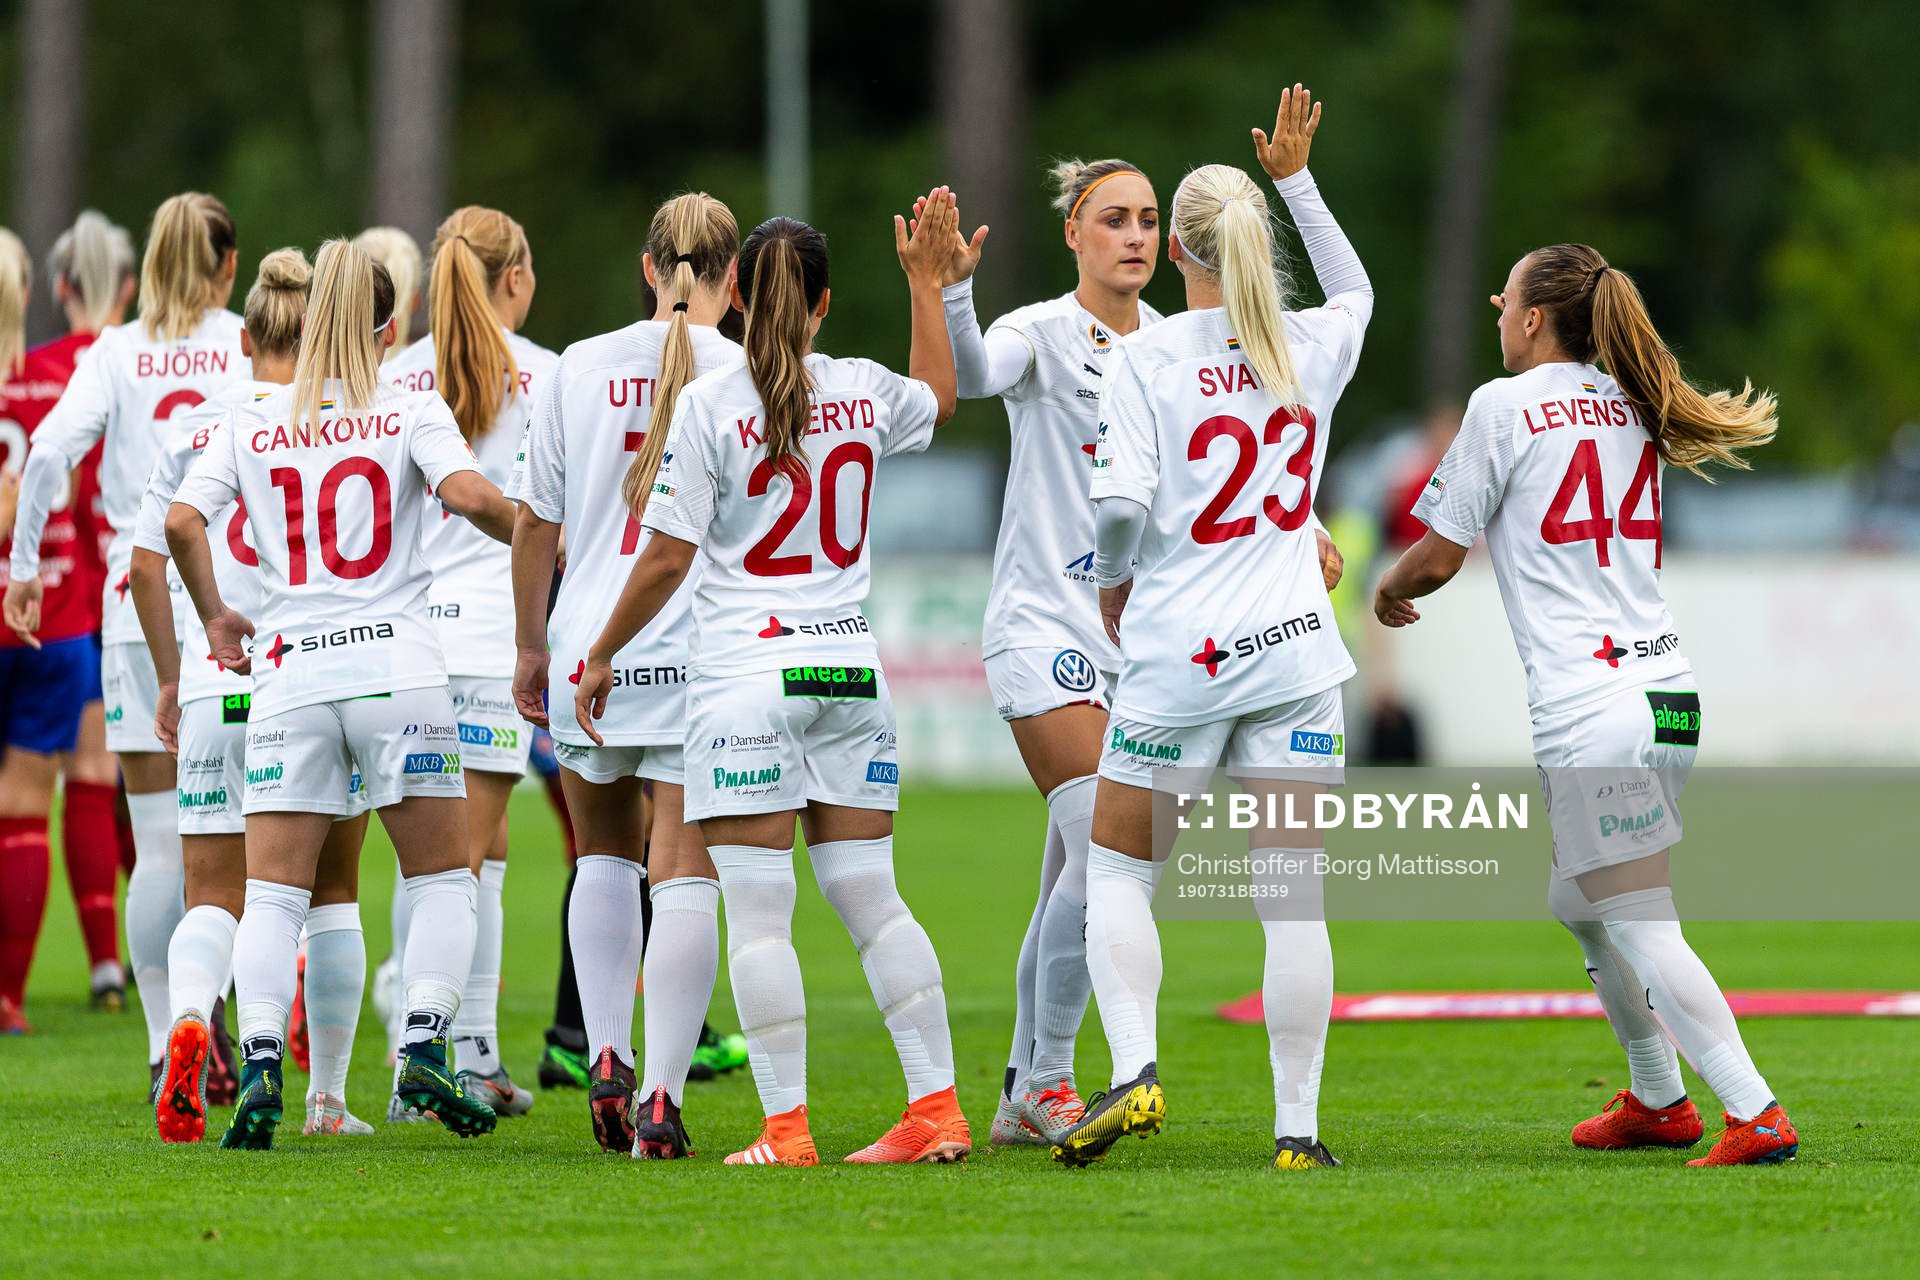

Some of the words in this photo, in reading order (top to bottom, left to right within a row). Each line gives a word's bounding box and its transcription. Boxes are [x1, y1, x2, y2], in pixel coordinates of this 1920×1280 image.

[138, 345, 228, 377] BJÖRN
[609, 377, 657, 407] UT
[1198, 363, 1266, 397] SVA
[251, 412, 401, 454] CANKOVIC
[737, 398, 875, 449] KERYD
[1522, 398, 1648, 436] LEVENST
[1187, 403, 1317, 545] 23
[269, 455, 392, 587] 10
[743, 441, 874, 577] 20
[1540, 438, 1664, 570] 44
[1655, 703, 1689, 731] akea
[730, 731, 780, 747] Damstahl
[1296, 734, 1331, 752] MKB
[409, 756, 440, 771] MKB
[871, 764, 897, 781] MKB
